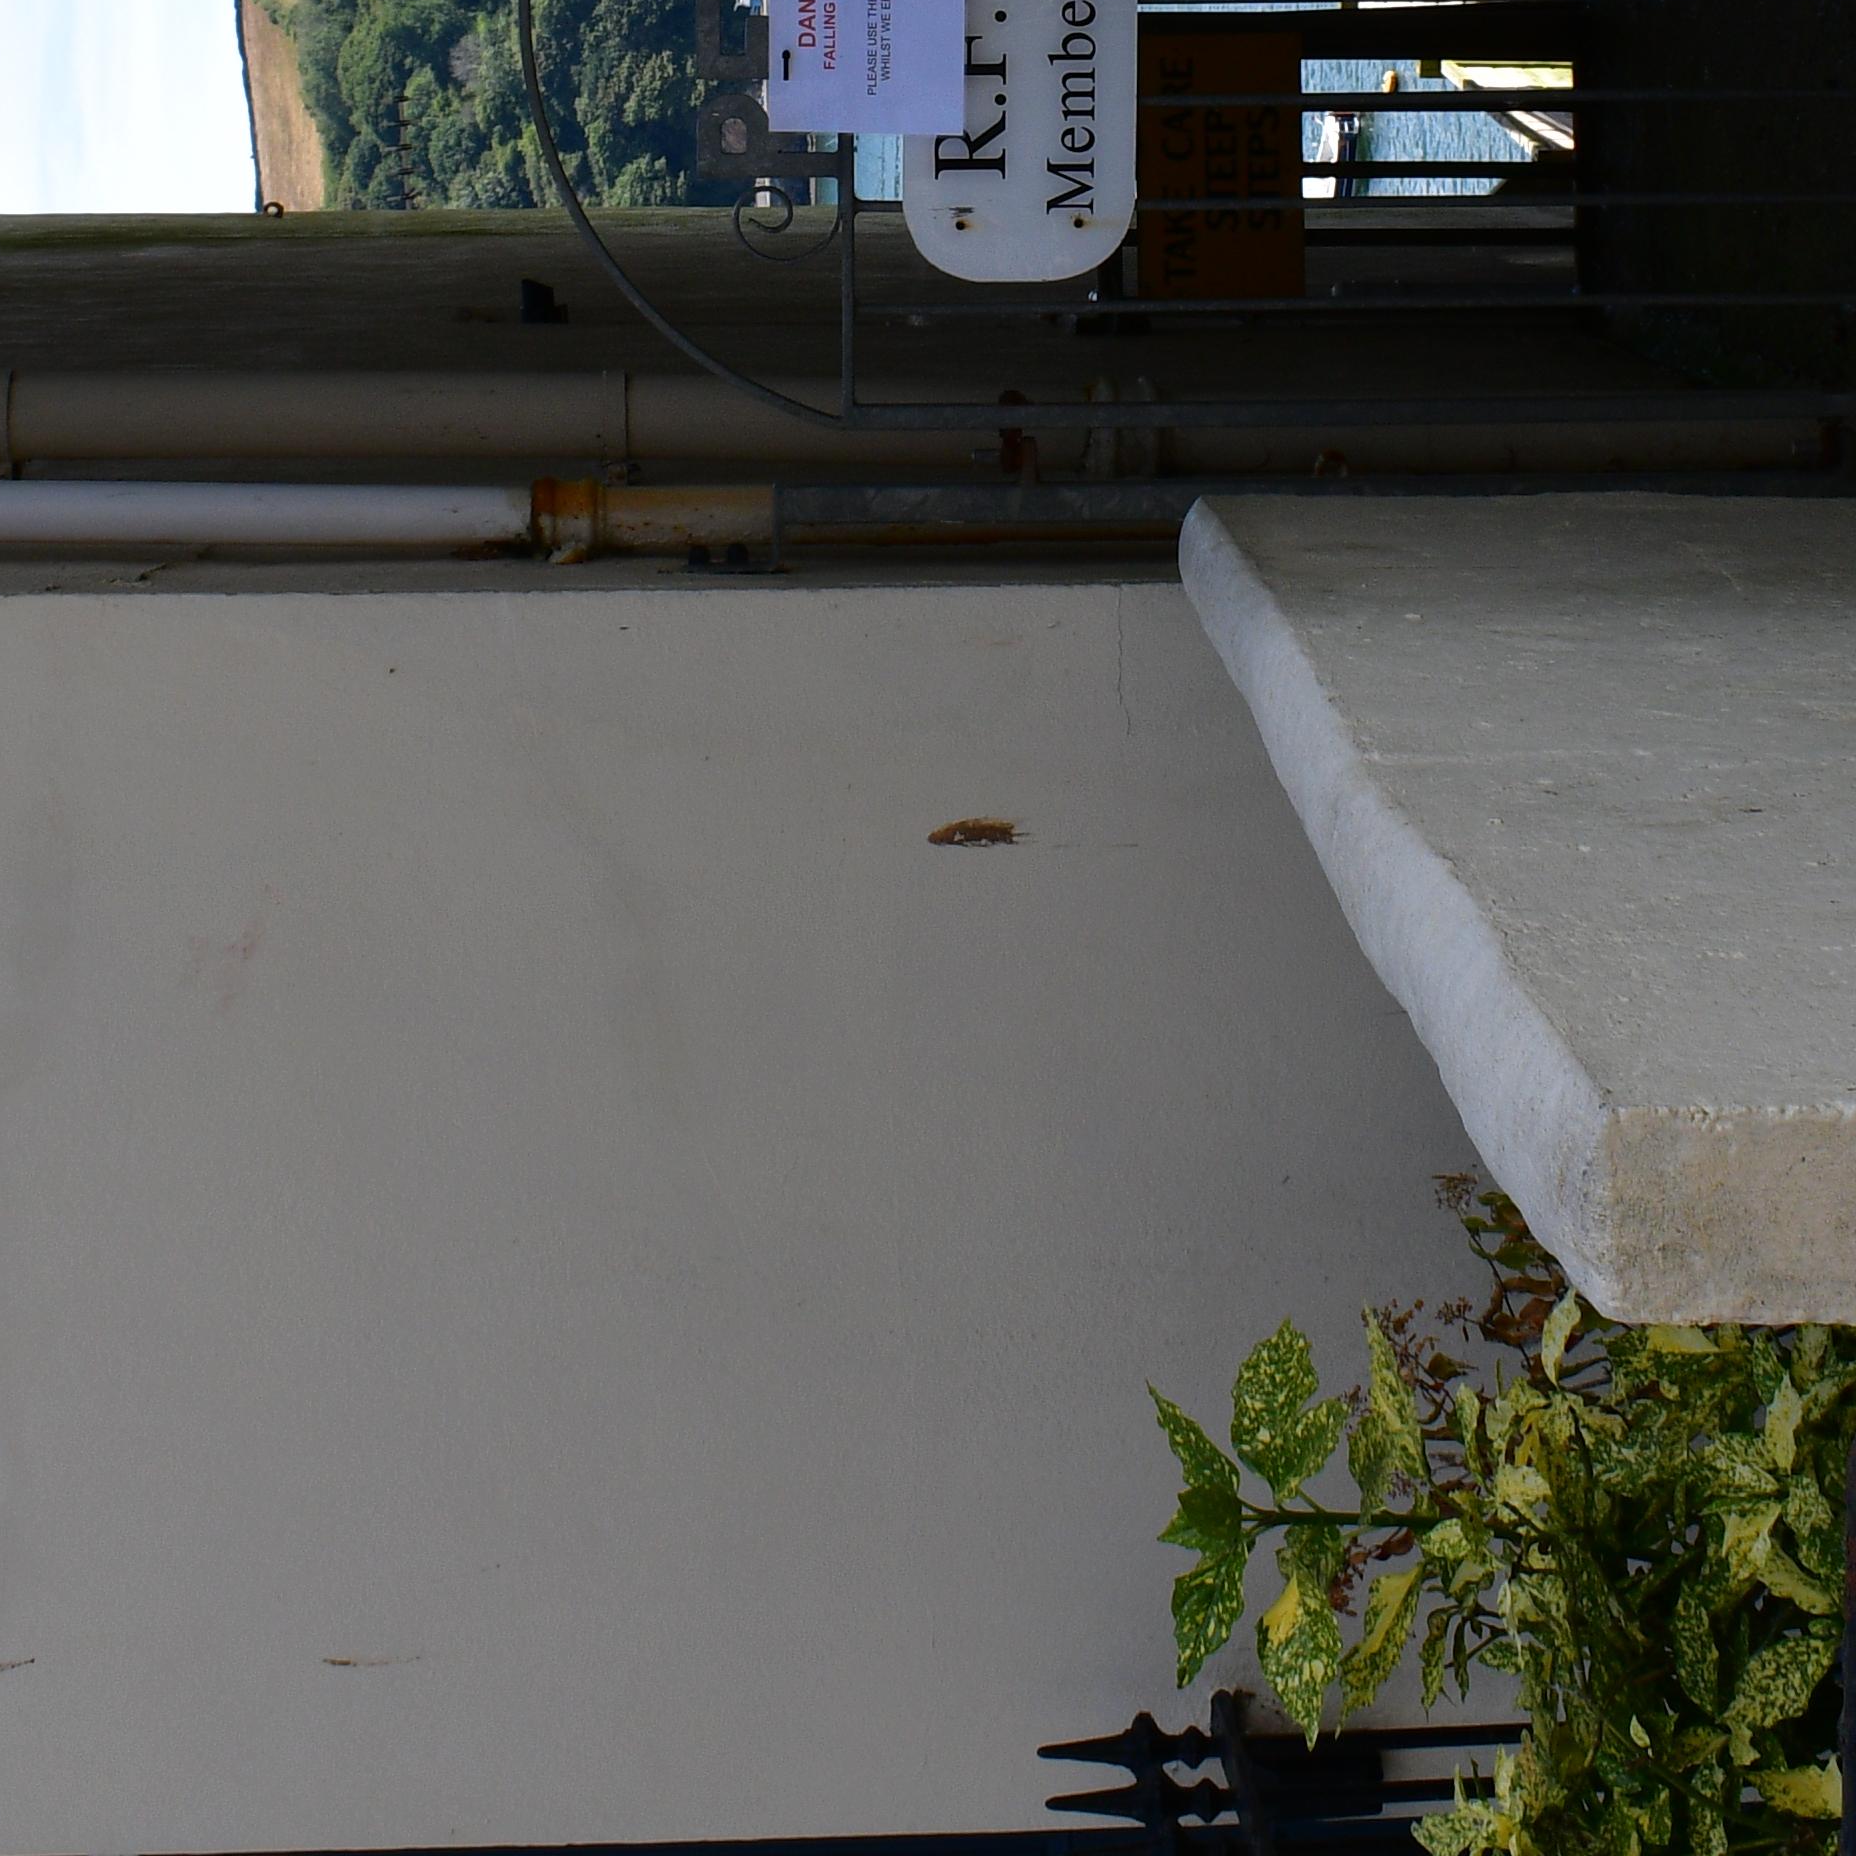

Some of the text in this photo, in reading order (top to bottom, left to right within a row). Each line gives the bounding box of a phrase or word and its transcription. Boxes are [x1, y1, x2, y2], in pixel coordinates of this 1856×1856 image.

[824, 2, 836, 70] FALLING
[868, 22, 878, 46] USE
[881, 13, 891, 32] WE
[868, 50, 877, 95] PLEASE
[881, 35, 891, 80] WHILST
[1161, 184, 1197, 286] TAKE
